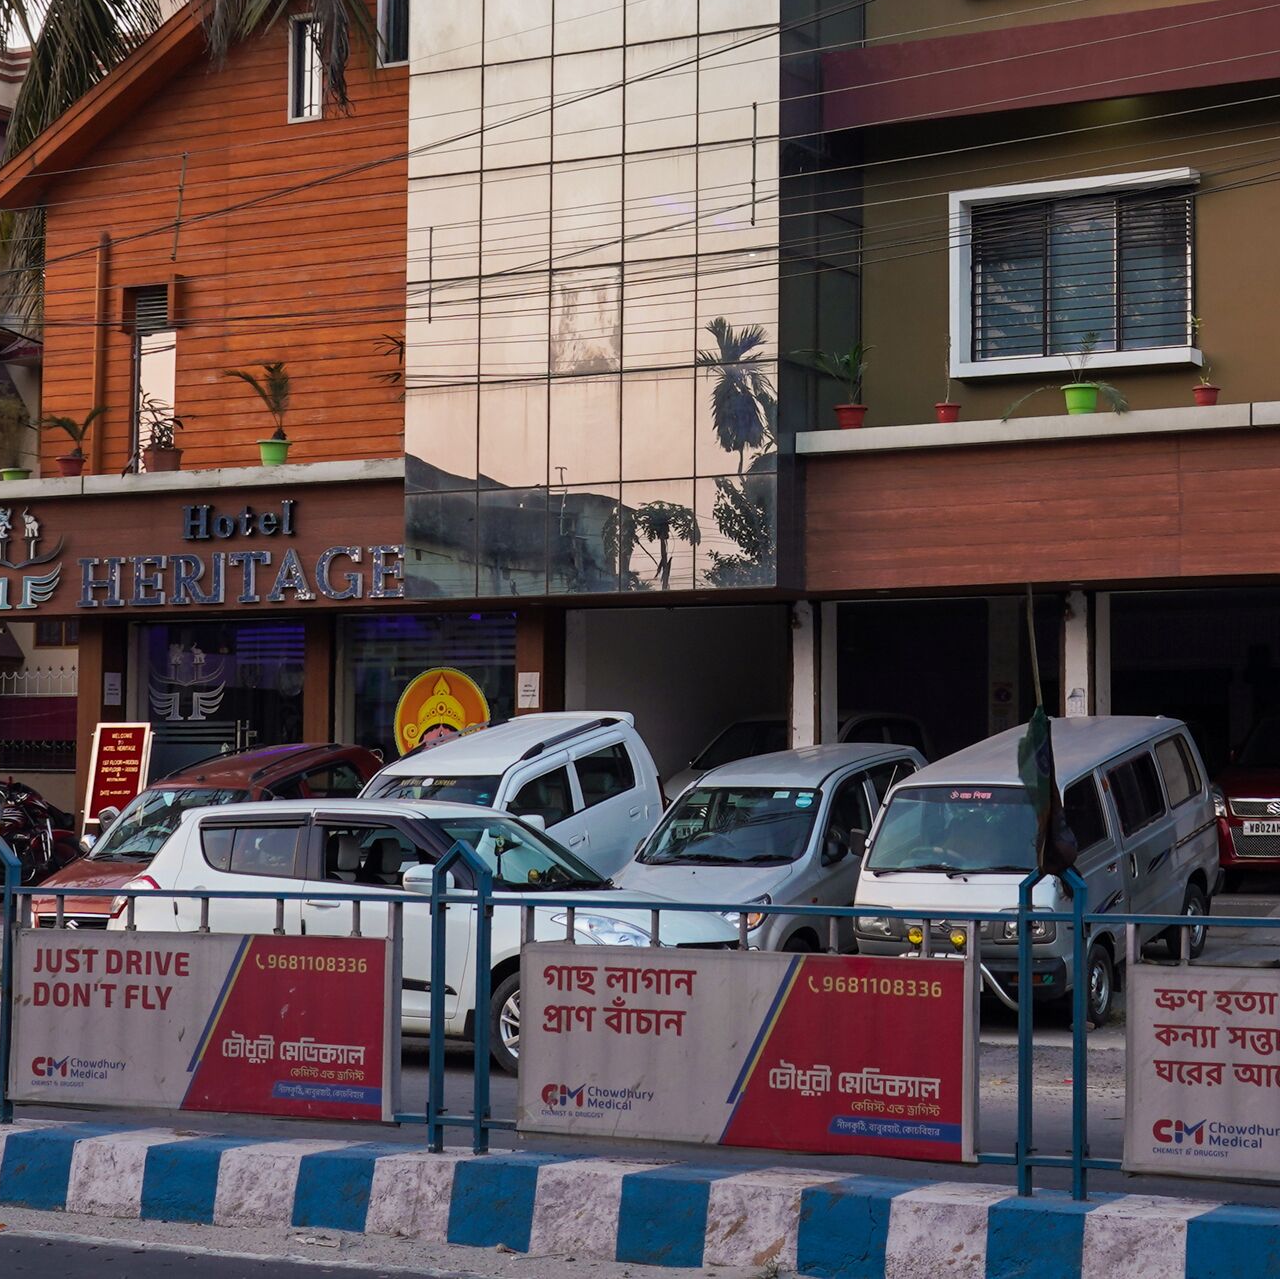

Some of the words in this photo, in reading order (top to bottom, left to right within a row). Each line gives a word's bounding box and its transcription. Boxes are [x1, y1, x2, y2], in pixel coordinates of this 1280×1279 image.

[182, 499, 297, 541] Hotel
[77, 544, 405, 608] HERITAGE
[33, 948, 99, 974] JUST
[105, 949, 190, 976] DRIVE
[268, 954, 367, 974] 9681108336
[543, 964, 597, 995] গাছ
[605, 966, 697, 997] লাগান
[823, 976, 943, 998] 9681108336
[33, 981, 116, 1008] DON'T
[125, 985, 172, 1011] FLY
[1154, 987, 1204, 1013] ভ্রুণ
[1214, 990, 1278, 1015] হত্যা
[542, 1005, 596, 1033] প্রাণ
[603, 996, 687, 1037] বাঁচান
[222, 1030, 274, 1064] চৌধুরী
[279, 1037, 365, 1066] মেডিক্যাল
[1154, 1024, 1217, 1048] কন্যা
[70, 1057, 126, 1072] Chowdhury
[70, 1068, 108, 1080] Medical
[1153, 1060, 1226, 1085] ঘরের
[769, 1060, 832, 1097] চৌধুরী
[838, 1067, 941, 1099] মেডিক্যাল
[587, 1086, 654, 1102] Chowdhury
[587, 1098, 632, 1111] Medical
[851, 1101, 884, 1114] কেমিস্ট
[907, 1103, 941, 1117] ড্রাগিস্ট
[1152, 1147, 1183, 1156] CHEMIST
[1194, 1149, 1229, 1158] DRUGGIST
[1209, 1135, 1262, 1149] Medical
